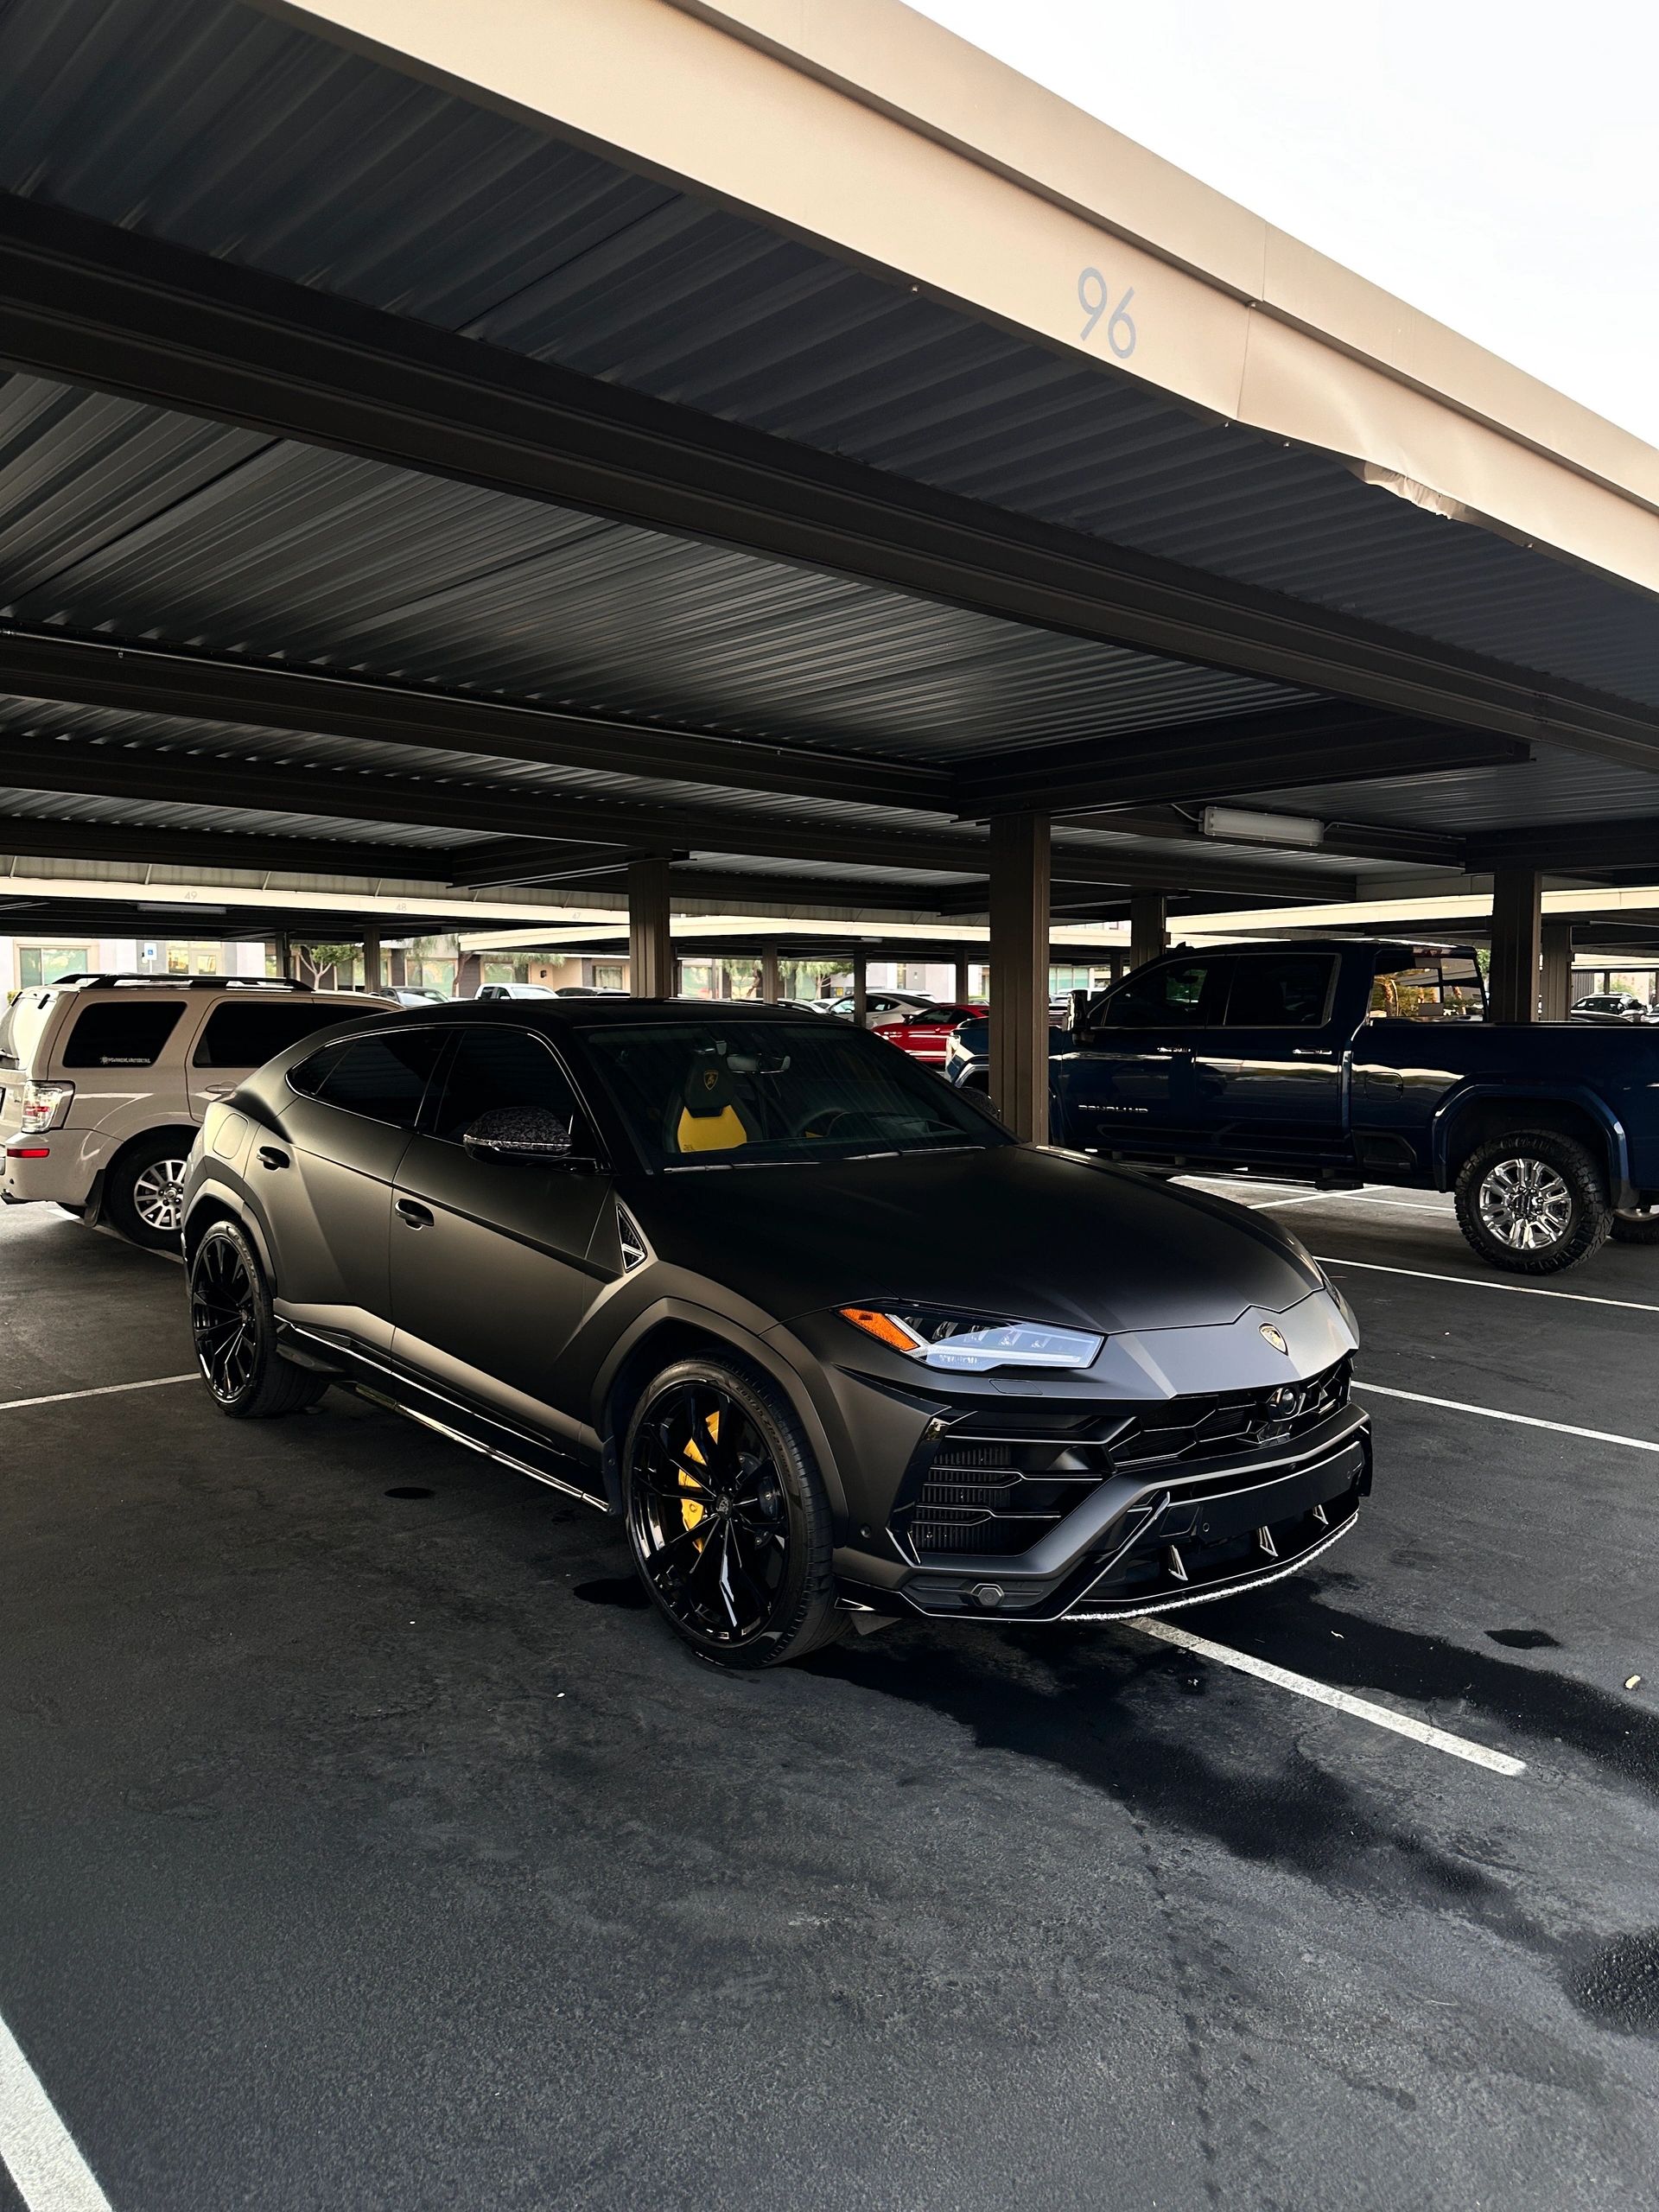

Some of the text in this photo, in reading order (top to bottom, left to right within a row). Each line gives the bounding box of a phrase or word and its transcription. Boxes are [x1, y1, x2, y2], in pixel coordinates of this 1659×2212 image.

[1077, 266, 1136, 359] 96
[184, 891, 198, 900] 49
[396, 903, 407, 912] 48
